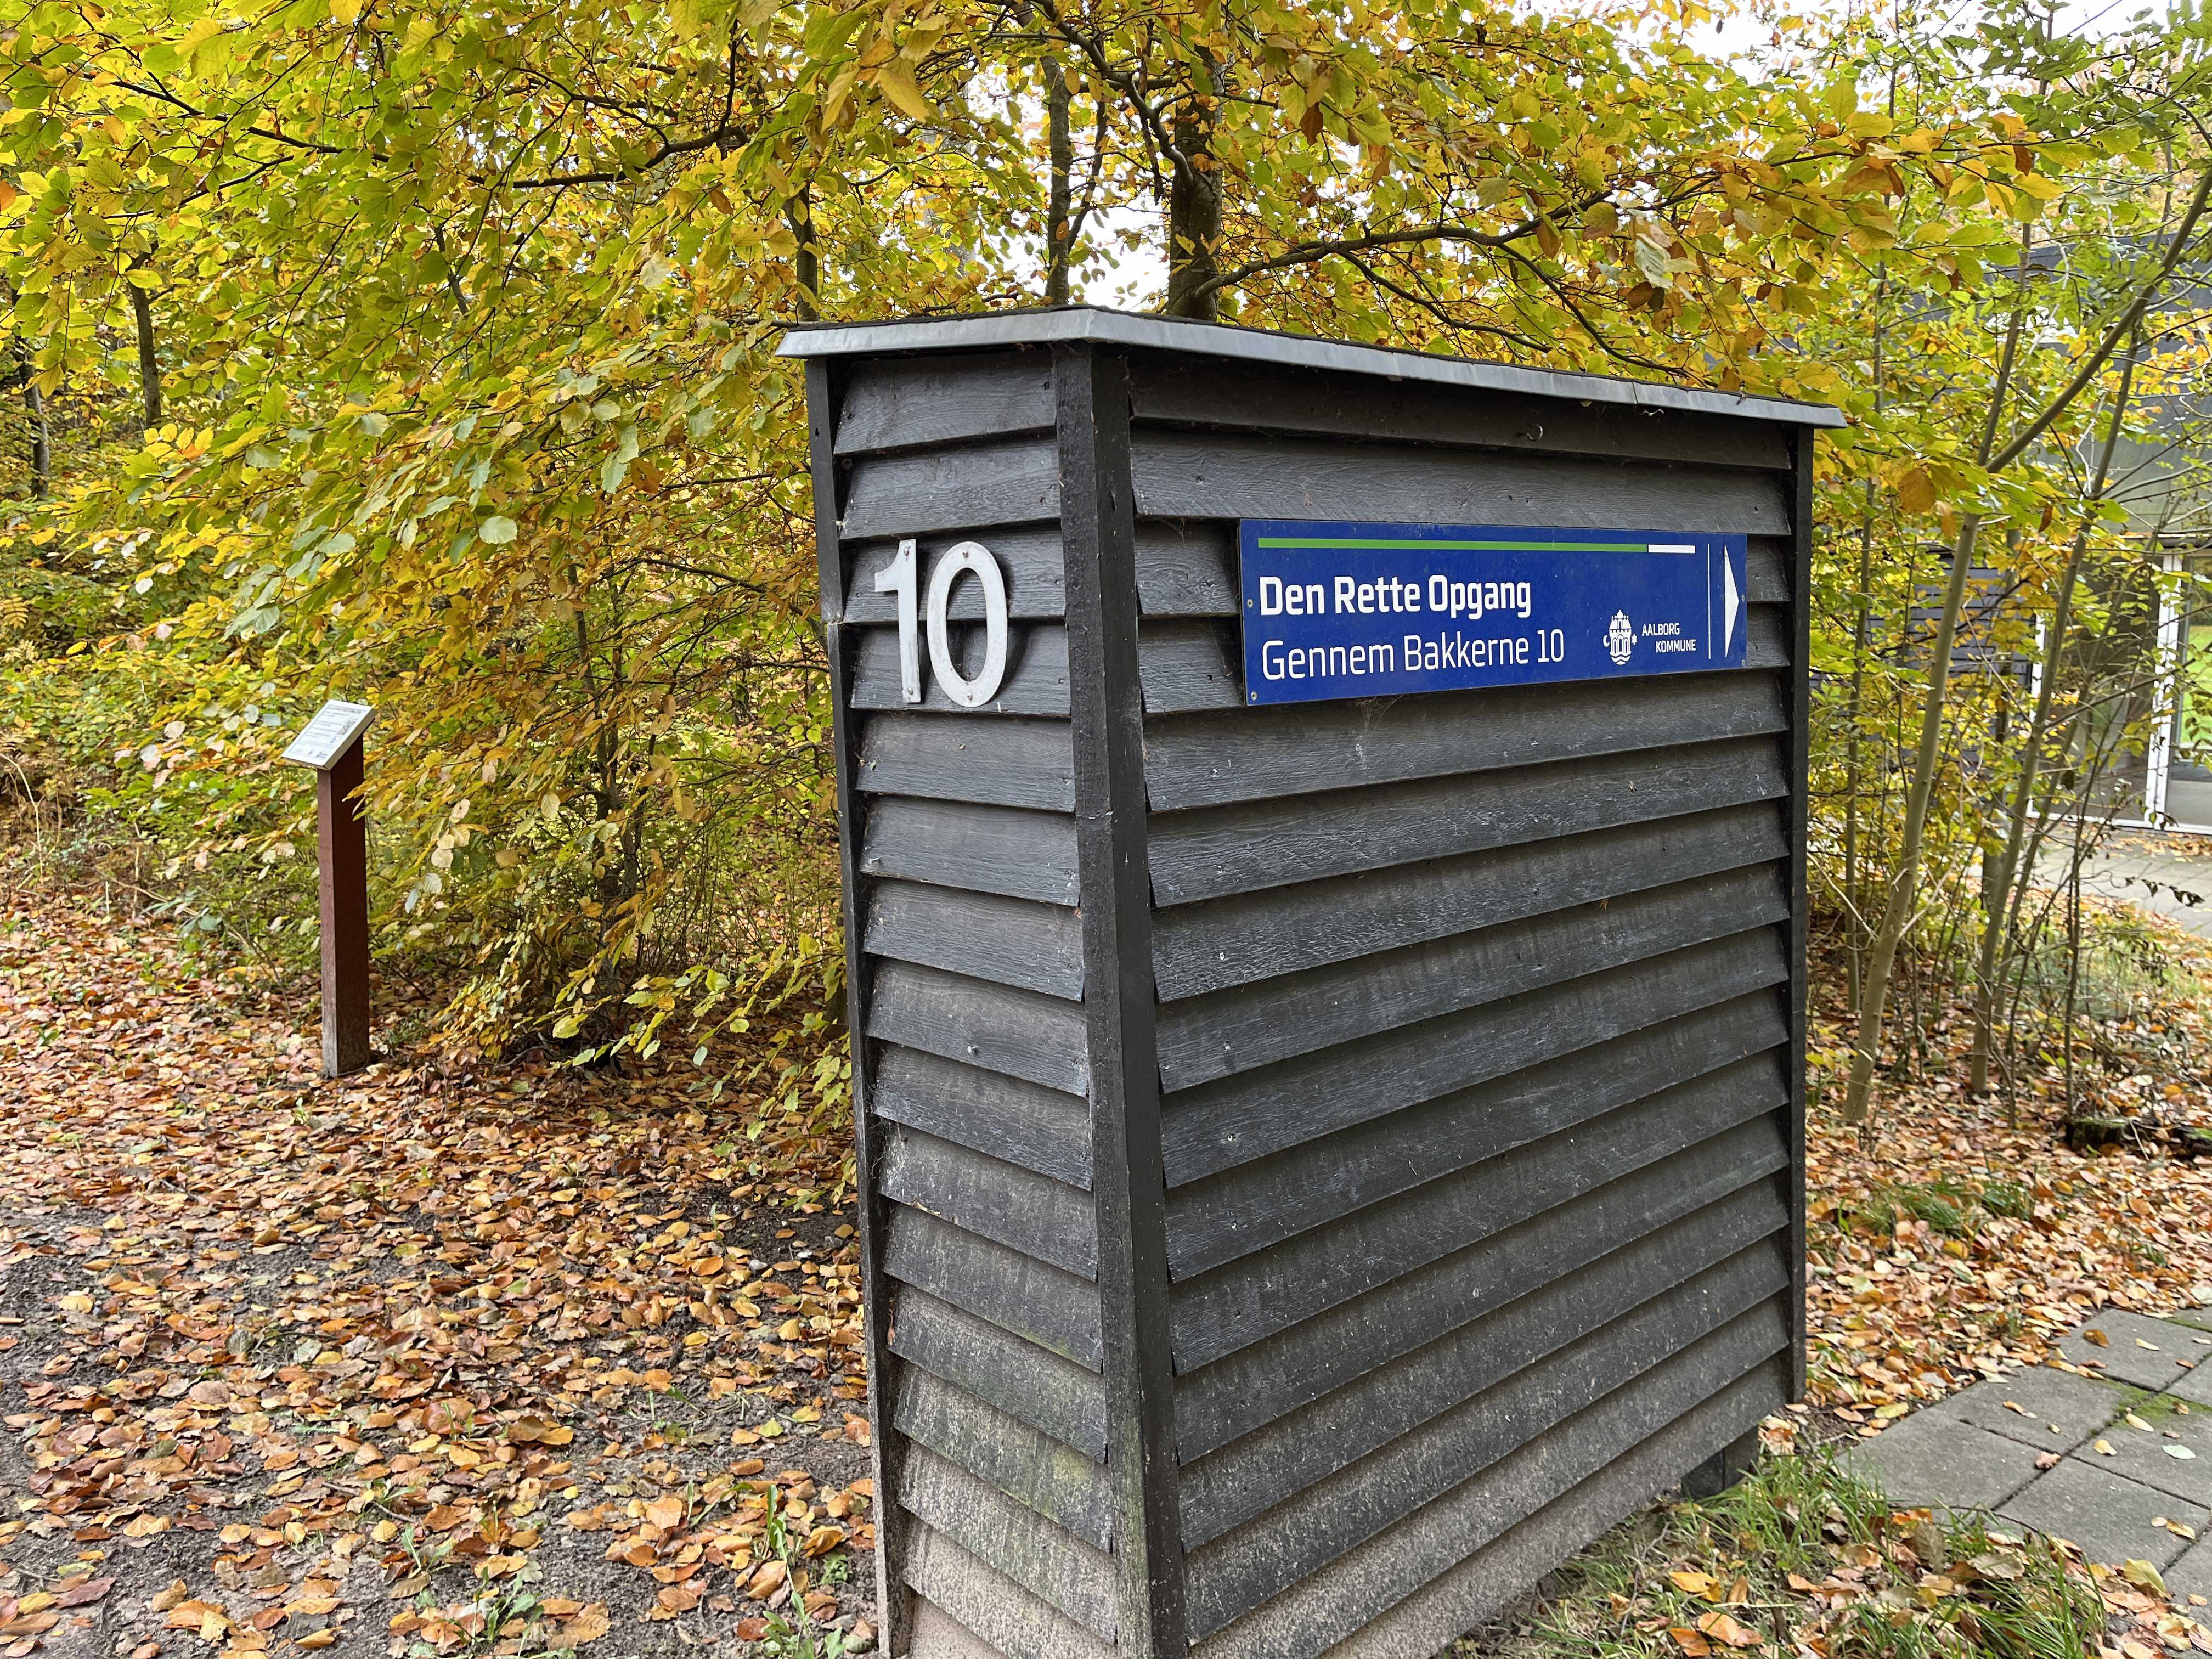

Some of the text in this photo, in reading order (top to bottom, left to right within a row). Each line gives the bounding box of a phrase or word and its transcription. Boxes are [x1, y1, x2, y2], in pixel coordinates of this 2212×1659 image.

[1259, 574, 1532, 620] Den Rette Opgang
[874, 538, 1008, 708] 10
[1641, 622, 1680, 637] AALBORG
[1655, 638, 1697, 653] KOMMUNE
[1262, 628, 1565, 681] Gennem Bakkerne 10
